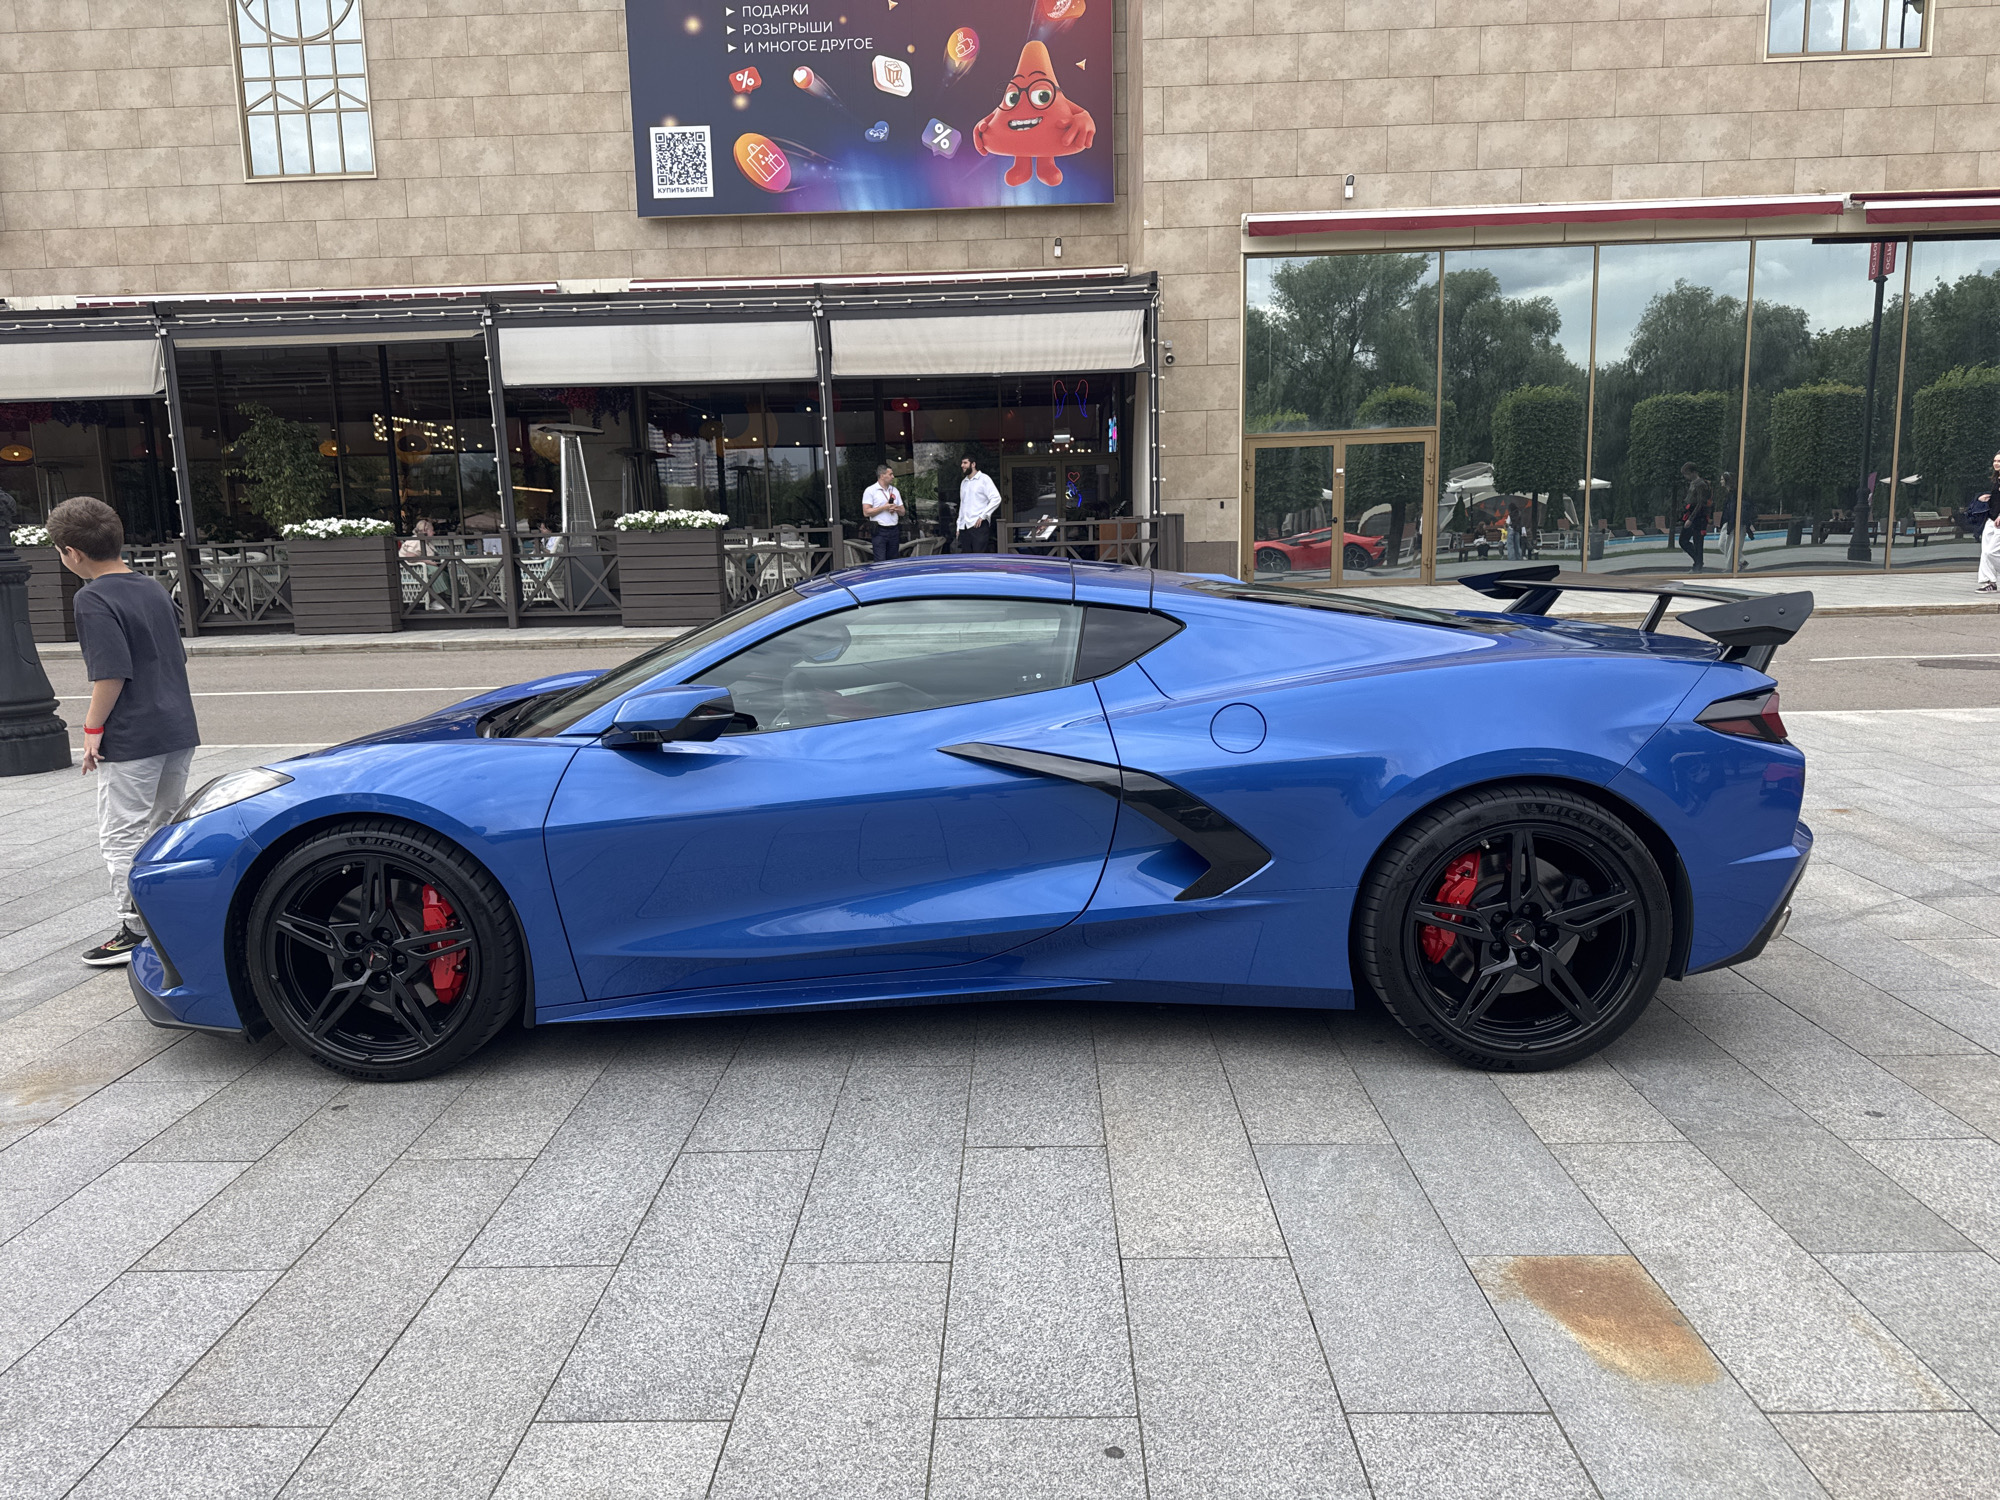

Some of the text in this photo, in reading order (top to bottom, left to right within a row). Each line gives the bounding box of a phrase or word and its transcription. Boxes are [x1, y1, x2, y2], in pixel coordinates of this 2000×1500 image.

[742, 4, 809, 19] ПОДАРКИ
[743, 21, 833, 36] РОЗЫГРЫШИ
[744, 37, 873, 54] И МНОГОЕ ДРУГОЕ
[657, 186, 685, 194] КУПИТЬ
[1543, 804, 1629, 849] MICHELIN
[363, 837, 434, 863] MICHELIN
